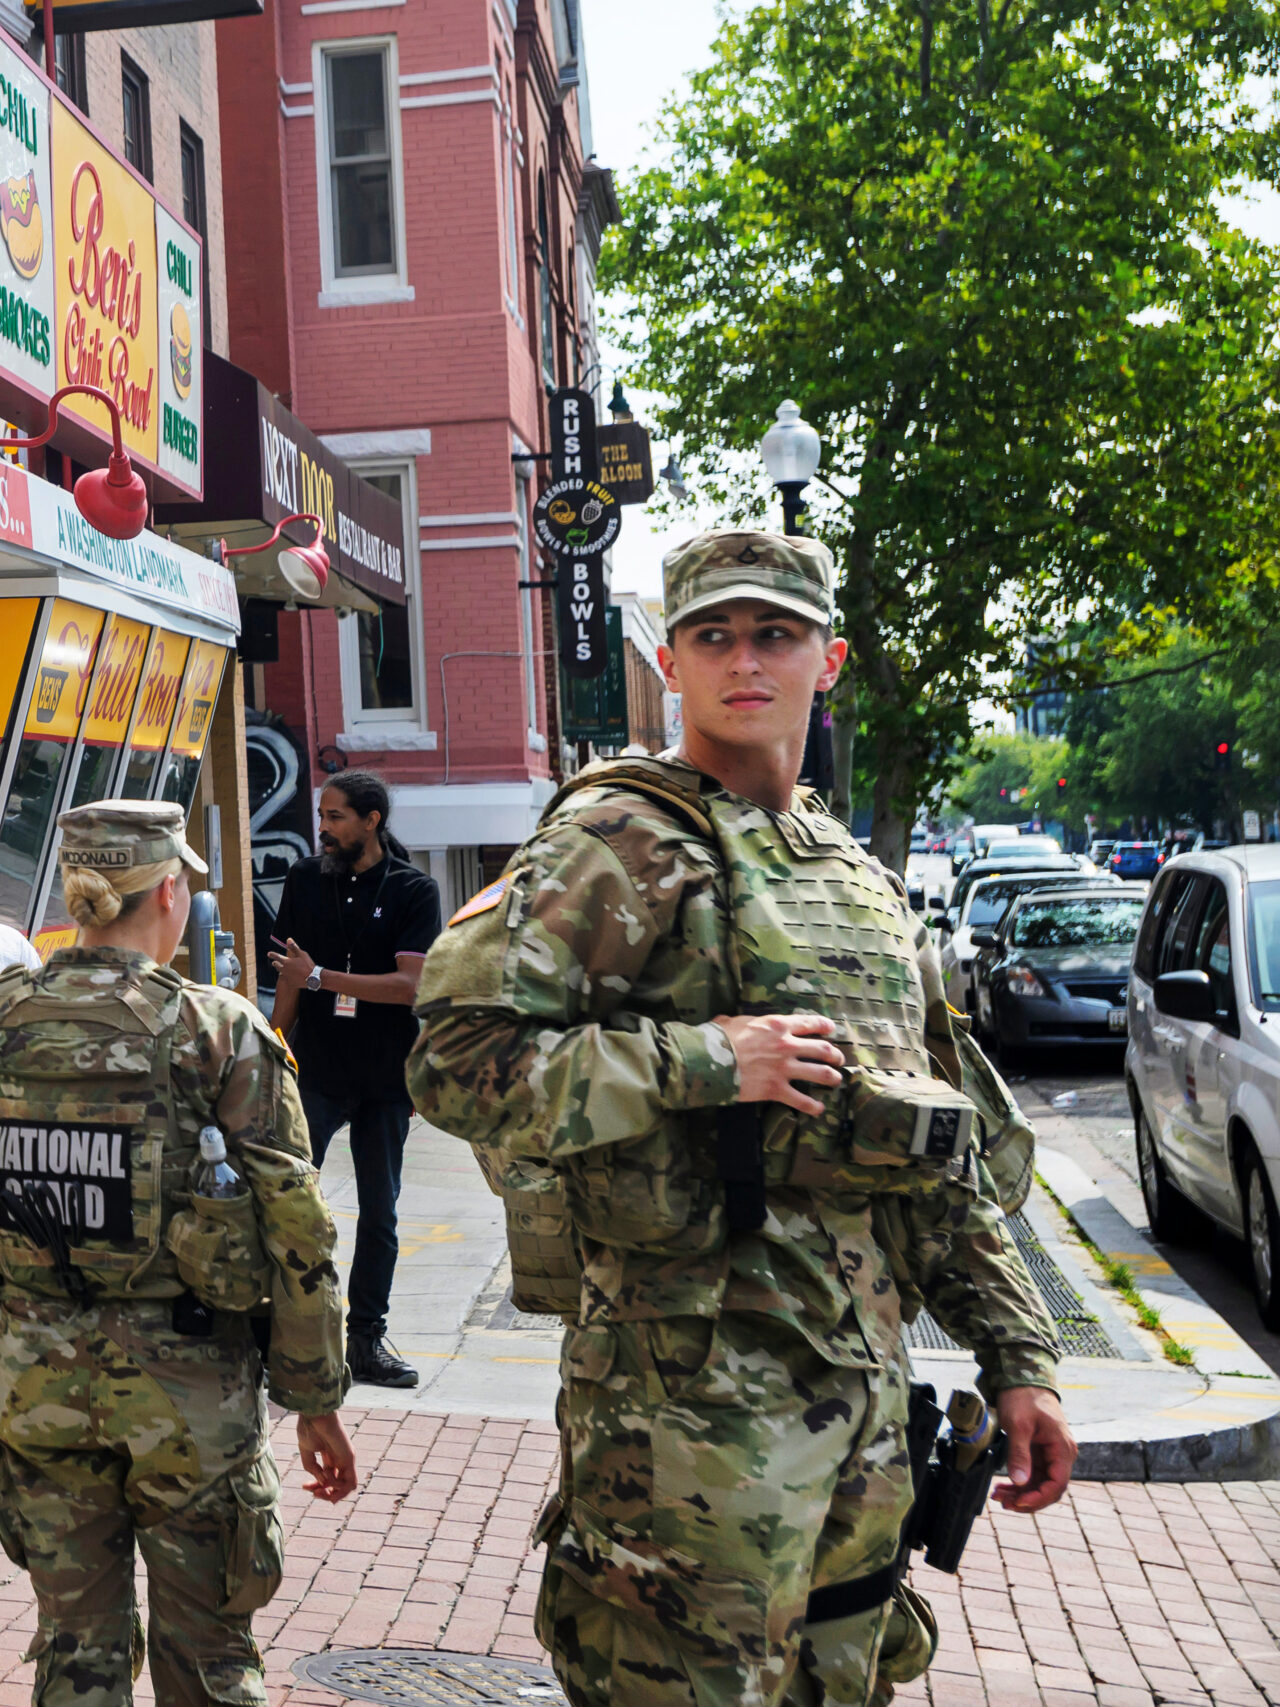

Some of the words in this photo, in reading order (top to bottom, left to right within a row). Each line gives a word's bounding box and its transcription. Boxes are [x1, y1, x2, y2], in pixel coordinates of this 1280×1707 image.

[69, 161, 142, 340] Ben's
[167, 239, 192, 298] CHILI
[65, 302, 107, 402] Chili
[109, 336, 154, 432] Bowl
[163, 402, 198, 465] BURGER
[562, 398, 582, 475] RUSH
[602, 443, 629, 463] THE
[537, 478, 584, 510] BLENDED
[586, 480, 615, 506] FRUIT
[600, 462, 643, 484] ALOON
[300, 450, 337, 544] DOOR
[338, 510, 381, 574] RESTAURANT
[387, 543, 403, 584] BAR
[537, 518, 562, 551] BOWLS
[572, 517, 619, 557] SMOOTHIES
[57, 505, 67, 551] A
[64, 508, 134, 580] WASHINGTON
[131, 541, 189, 599] LANDMARK
[570, 563, 595, 662] BOWLS
[62, 851, 128, 865] MCDONALD
